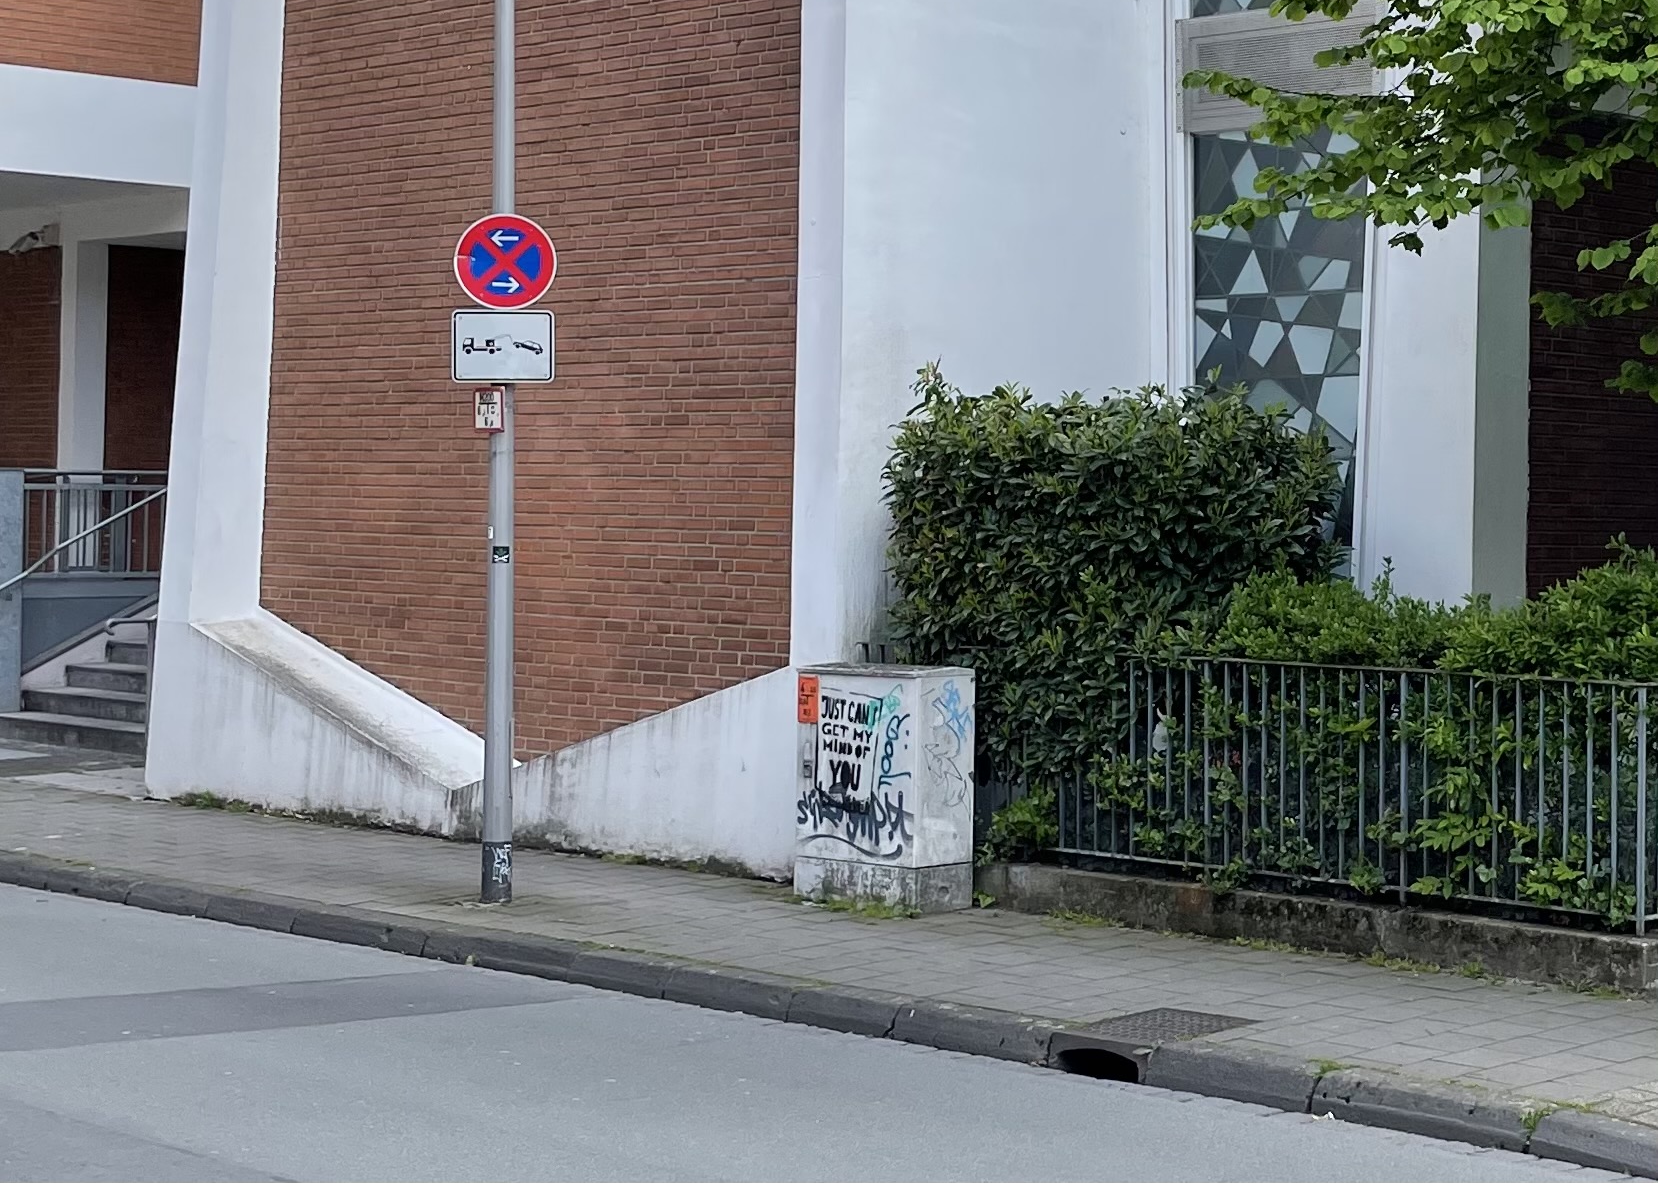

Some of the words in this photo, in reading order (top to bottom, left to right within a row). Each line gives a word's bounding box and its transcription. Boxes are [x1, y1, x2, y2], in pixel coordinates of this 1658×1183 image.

[821, 695, 847, 720] JUST
[822, 722, 849, 738] GET
[853, 728, 873, 744] MY
[823, 738, 853, 755] MIND
[855, 744, 871, 759] OF
[829, 759, 861, 793] YOU
